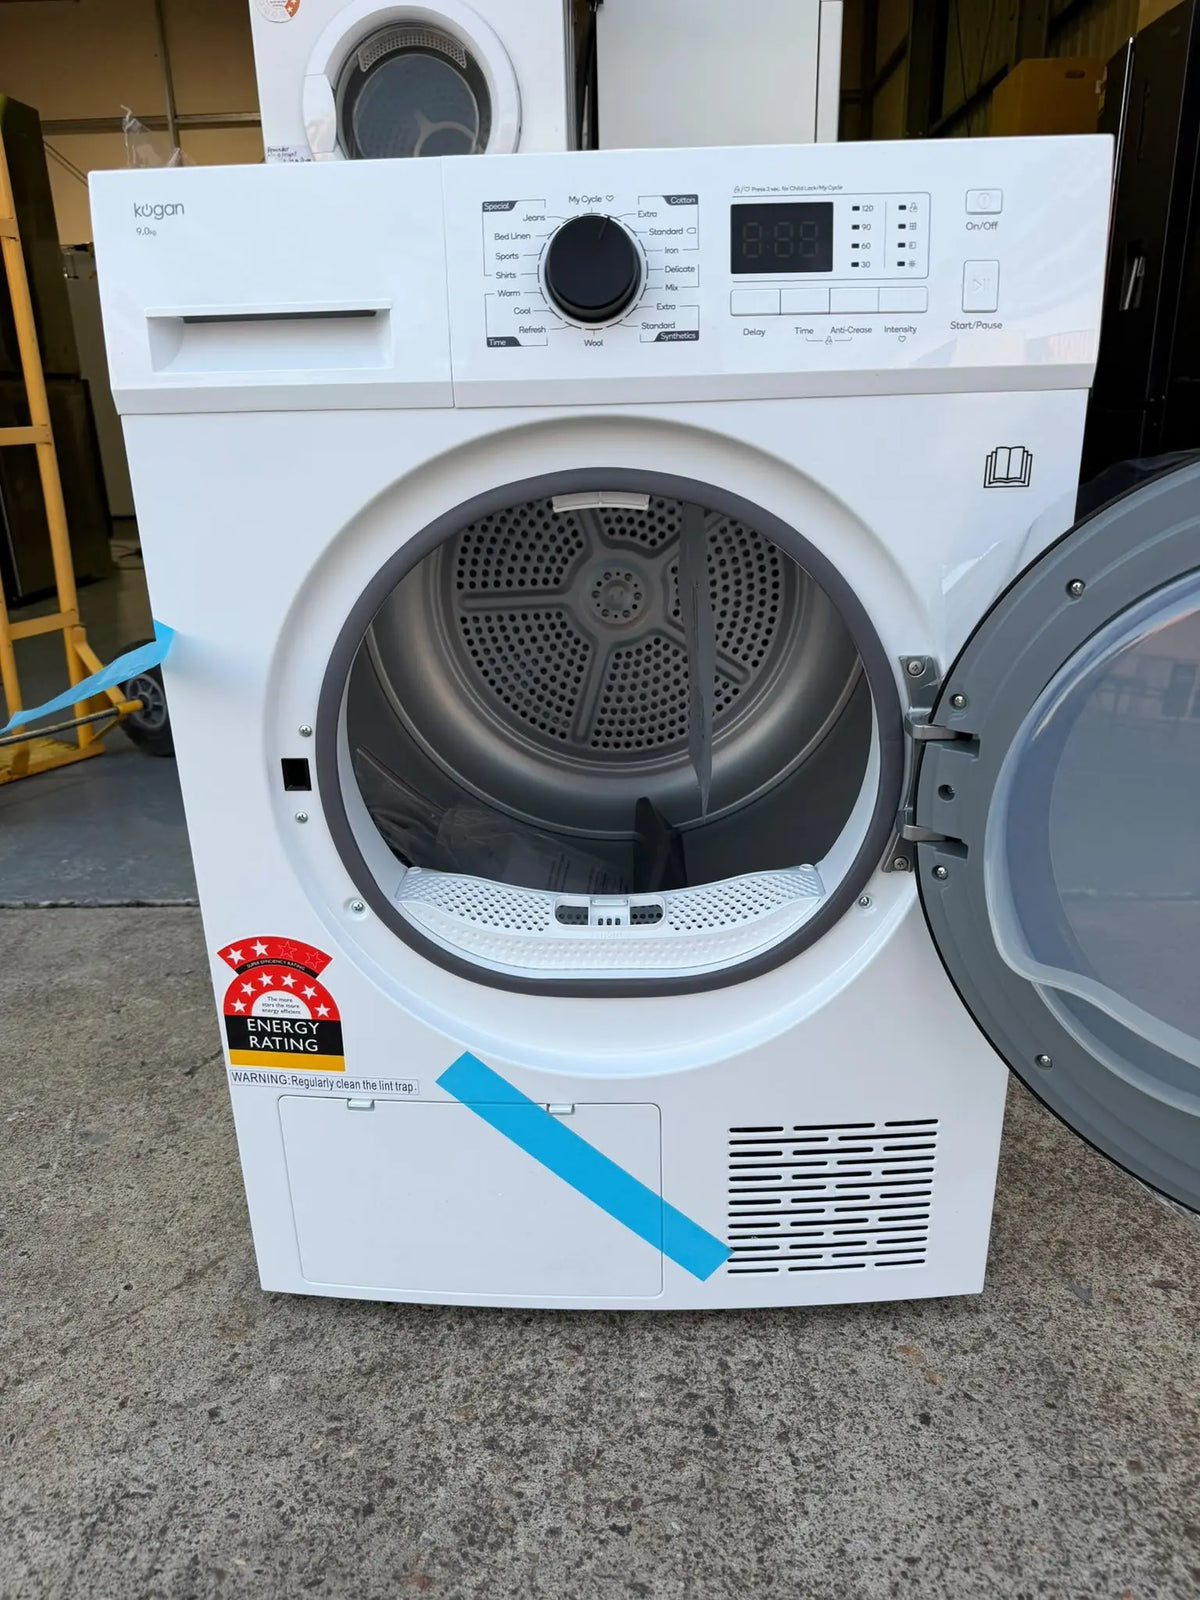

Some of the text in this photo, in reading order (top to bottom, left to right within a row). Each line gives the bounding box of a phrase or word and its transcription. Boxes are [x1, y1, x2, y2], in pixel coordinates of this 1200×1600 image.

[568, 195, 602, 205] My Cycle
[670, 196, 696, 204] Cotton
[484, 202, 510, 211] Special
[522, 214, 546, 222] Jeans
[638, 210, 657, 218] Extra
[966, 221, 998, 231] On/Off
[510, 232, 531, 240] Linen
[861, 242, 871, 250] 60
[496, 252, 519, 261] Sports
[665, 265, 695, 273] Delicate
[496, 271, 516, 279] Shirts
[884, 325, 917, 334] Intensity
[950, 321, 1003, 330] Start/Pause
[519, 326, 546, 334] Refresh
[743, 328, 766, 337] Delay
[830, 326, 872, 334] Anti-Crease
[660, 333, 696, 341] Synthetics
[488, 338, 507, 346] Time
[247, 1018, 320, 1035] ENERGY
[249, 1035, 319, 1052] RATING
[336, 1078, 361, 1090] clean
[362, 1080, 377, 1090] the
[379, 1080, 393, 1091] lint
